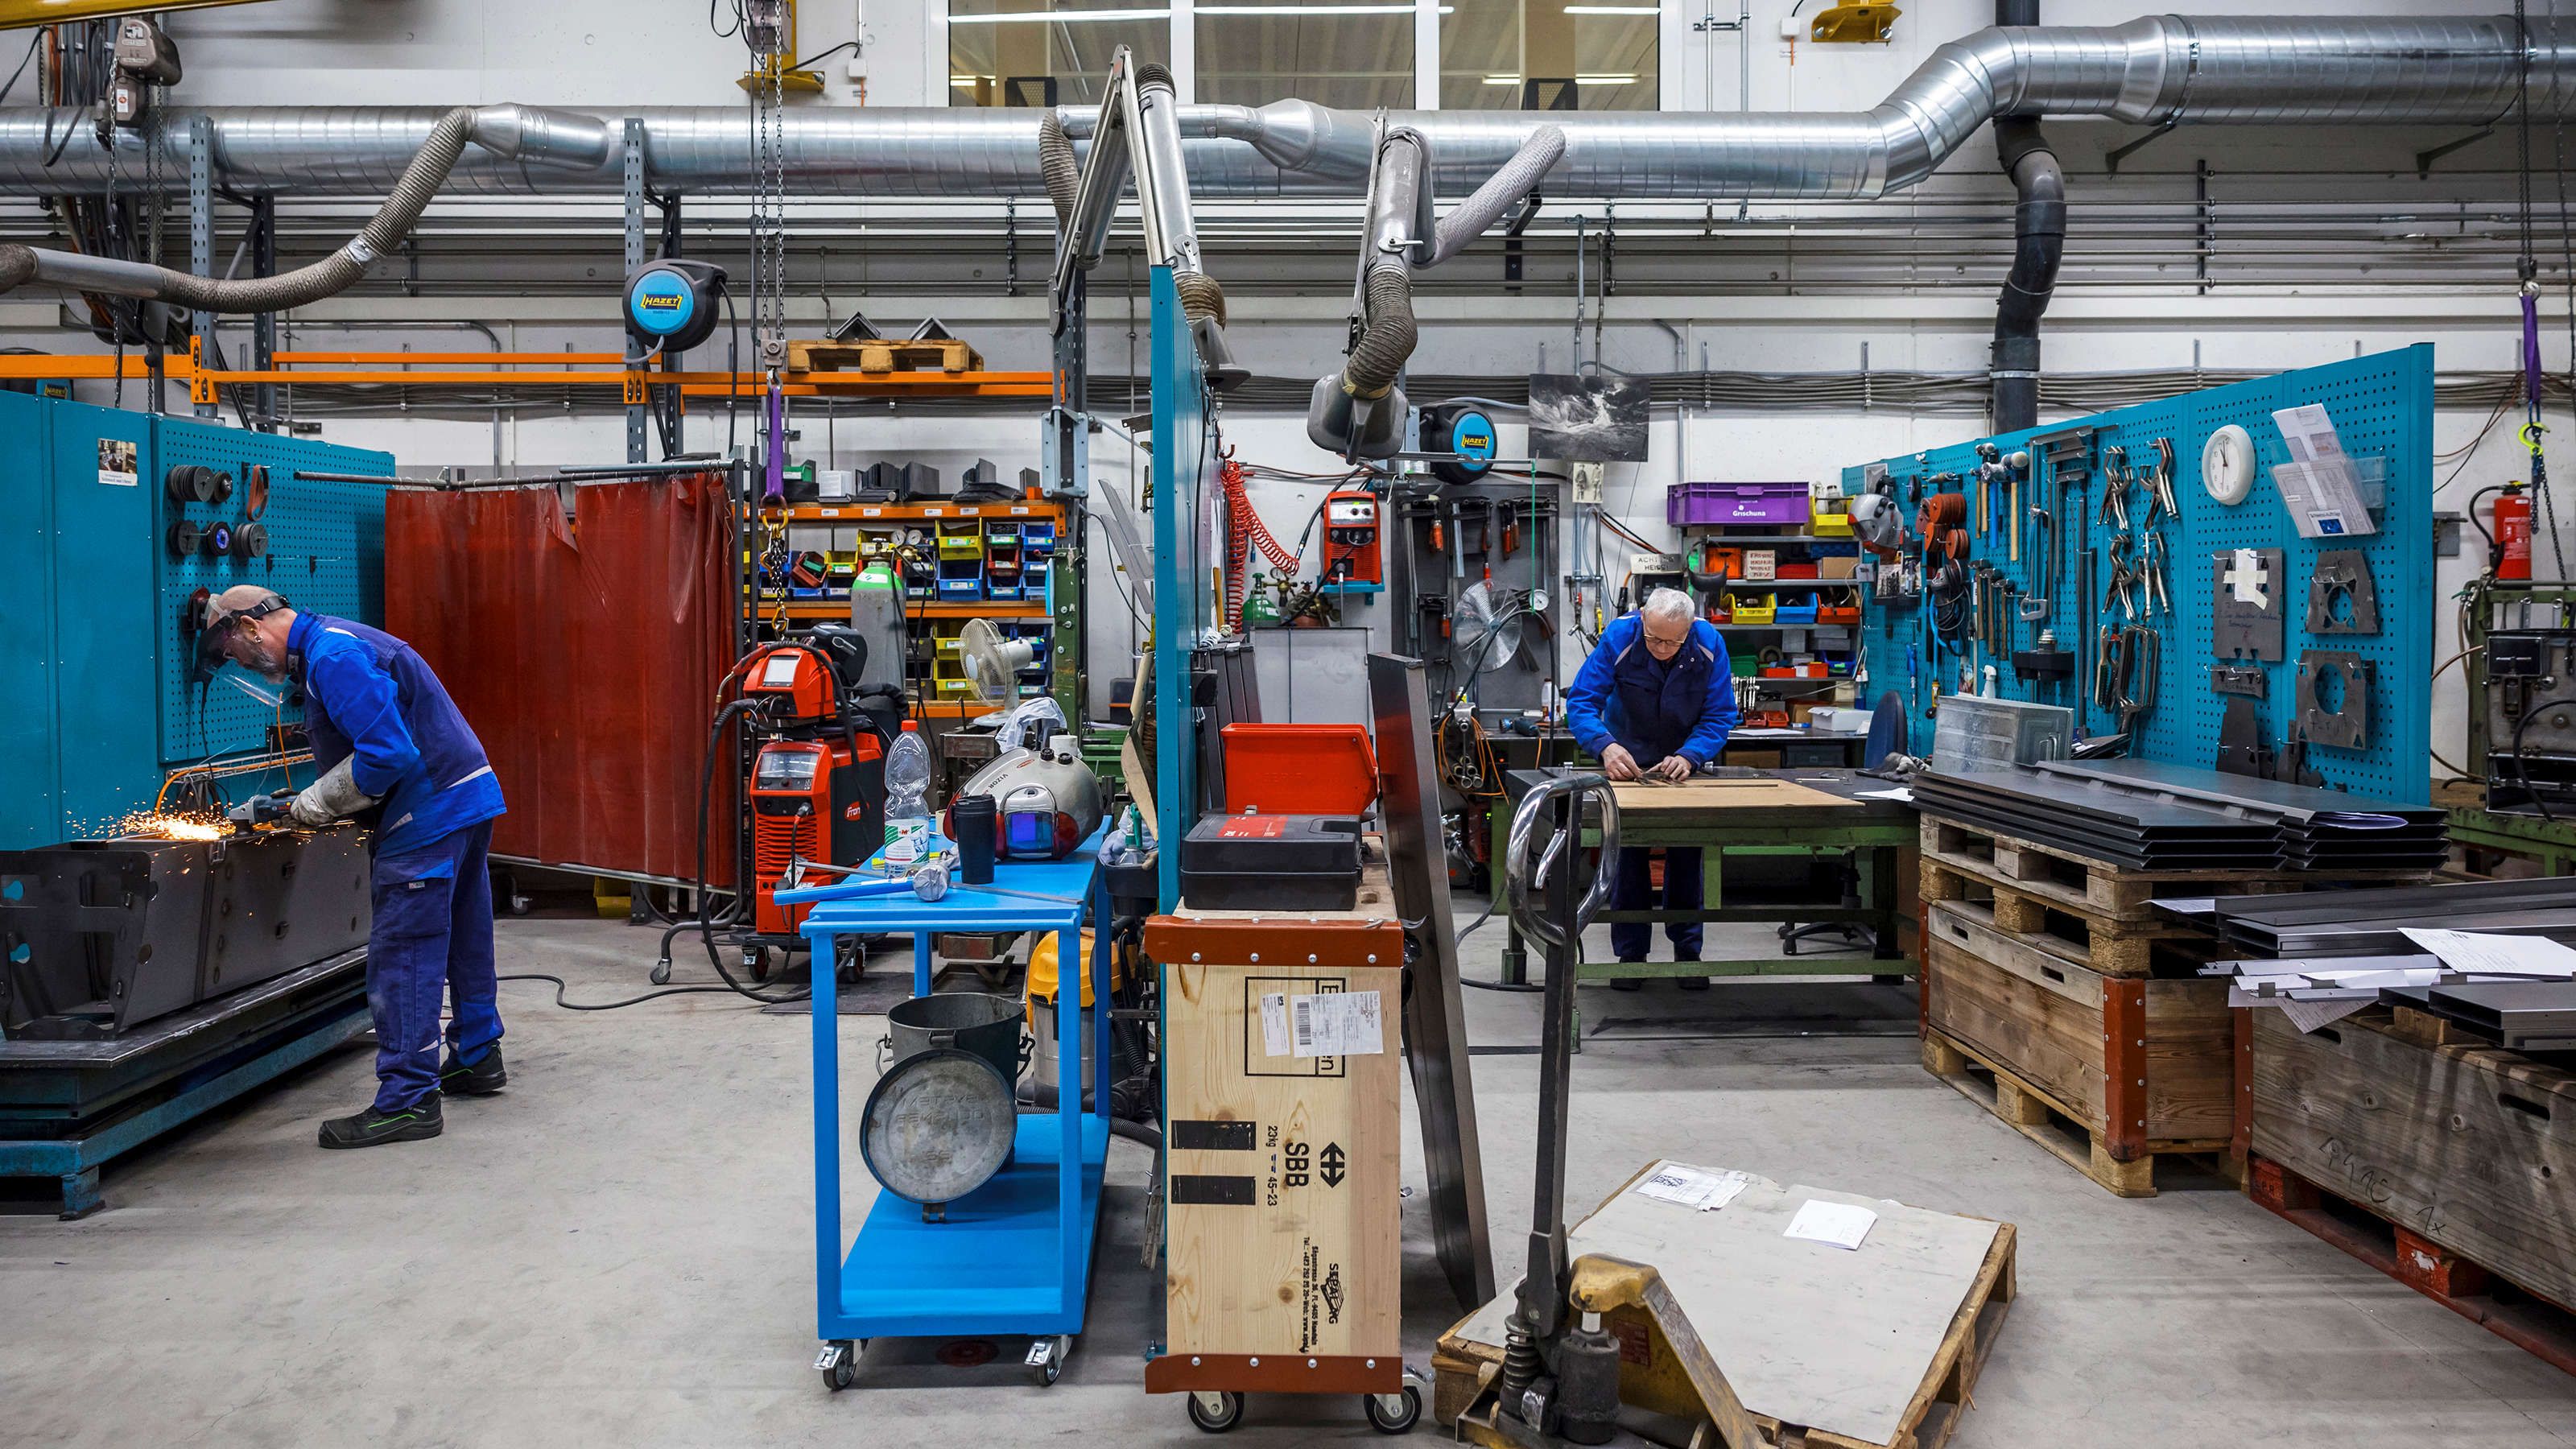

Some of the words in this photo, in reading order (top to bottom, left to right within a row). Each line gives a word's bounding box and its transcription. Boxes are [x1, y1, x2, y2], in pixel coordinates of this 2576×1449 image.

[643, 295, 679, 307] HAZET
[1463, 436, 1487, 447] HAZET
[988, 773, 1009, 789] VIZOR
[1285, 1142, 1310, 1187] SBB
[1267, 1176, 1278, 1206] 45-23
[1329, 1263, 1340, 1302] SEPAL
[1328, 1307, 1339, 1324] AG
